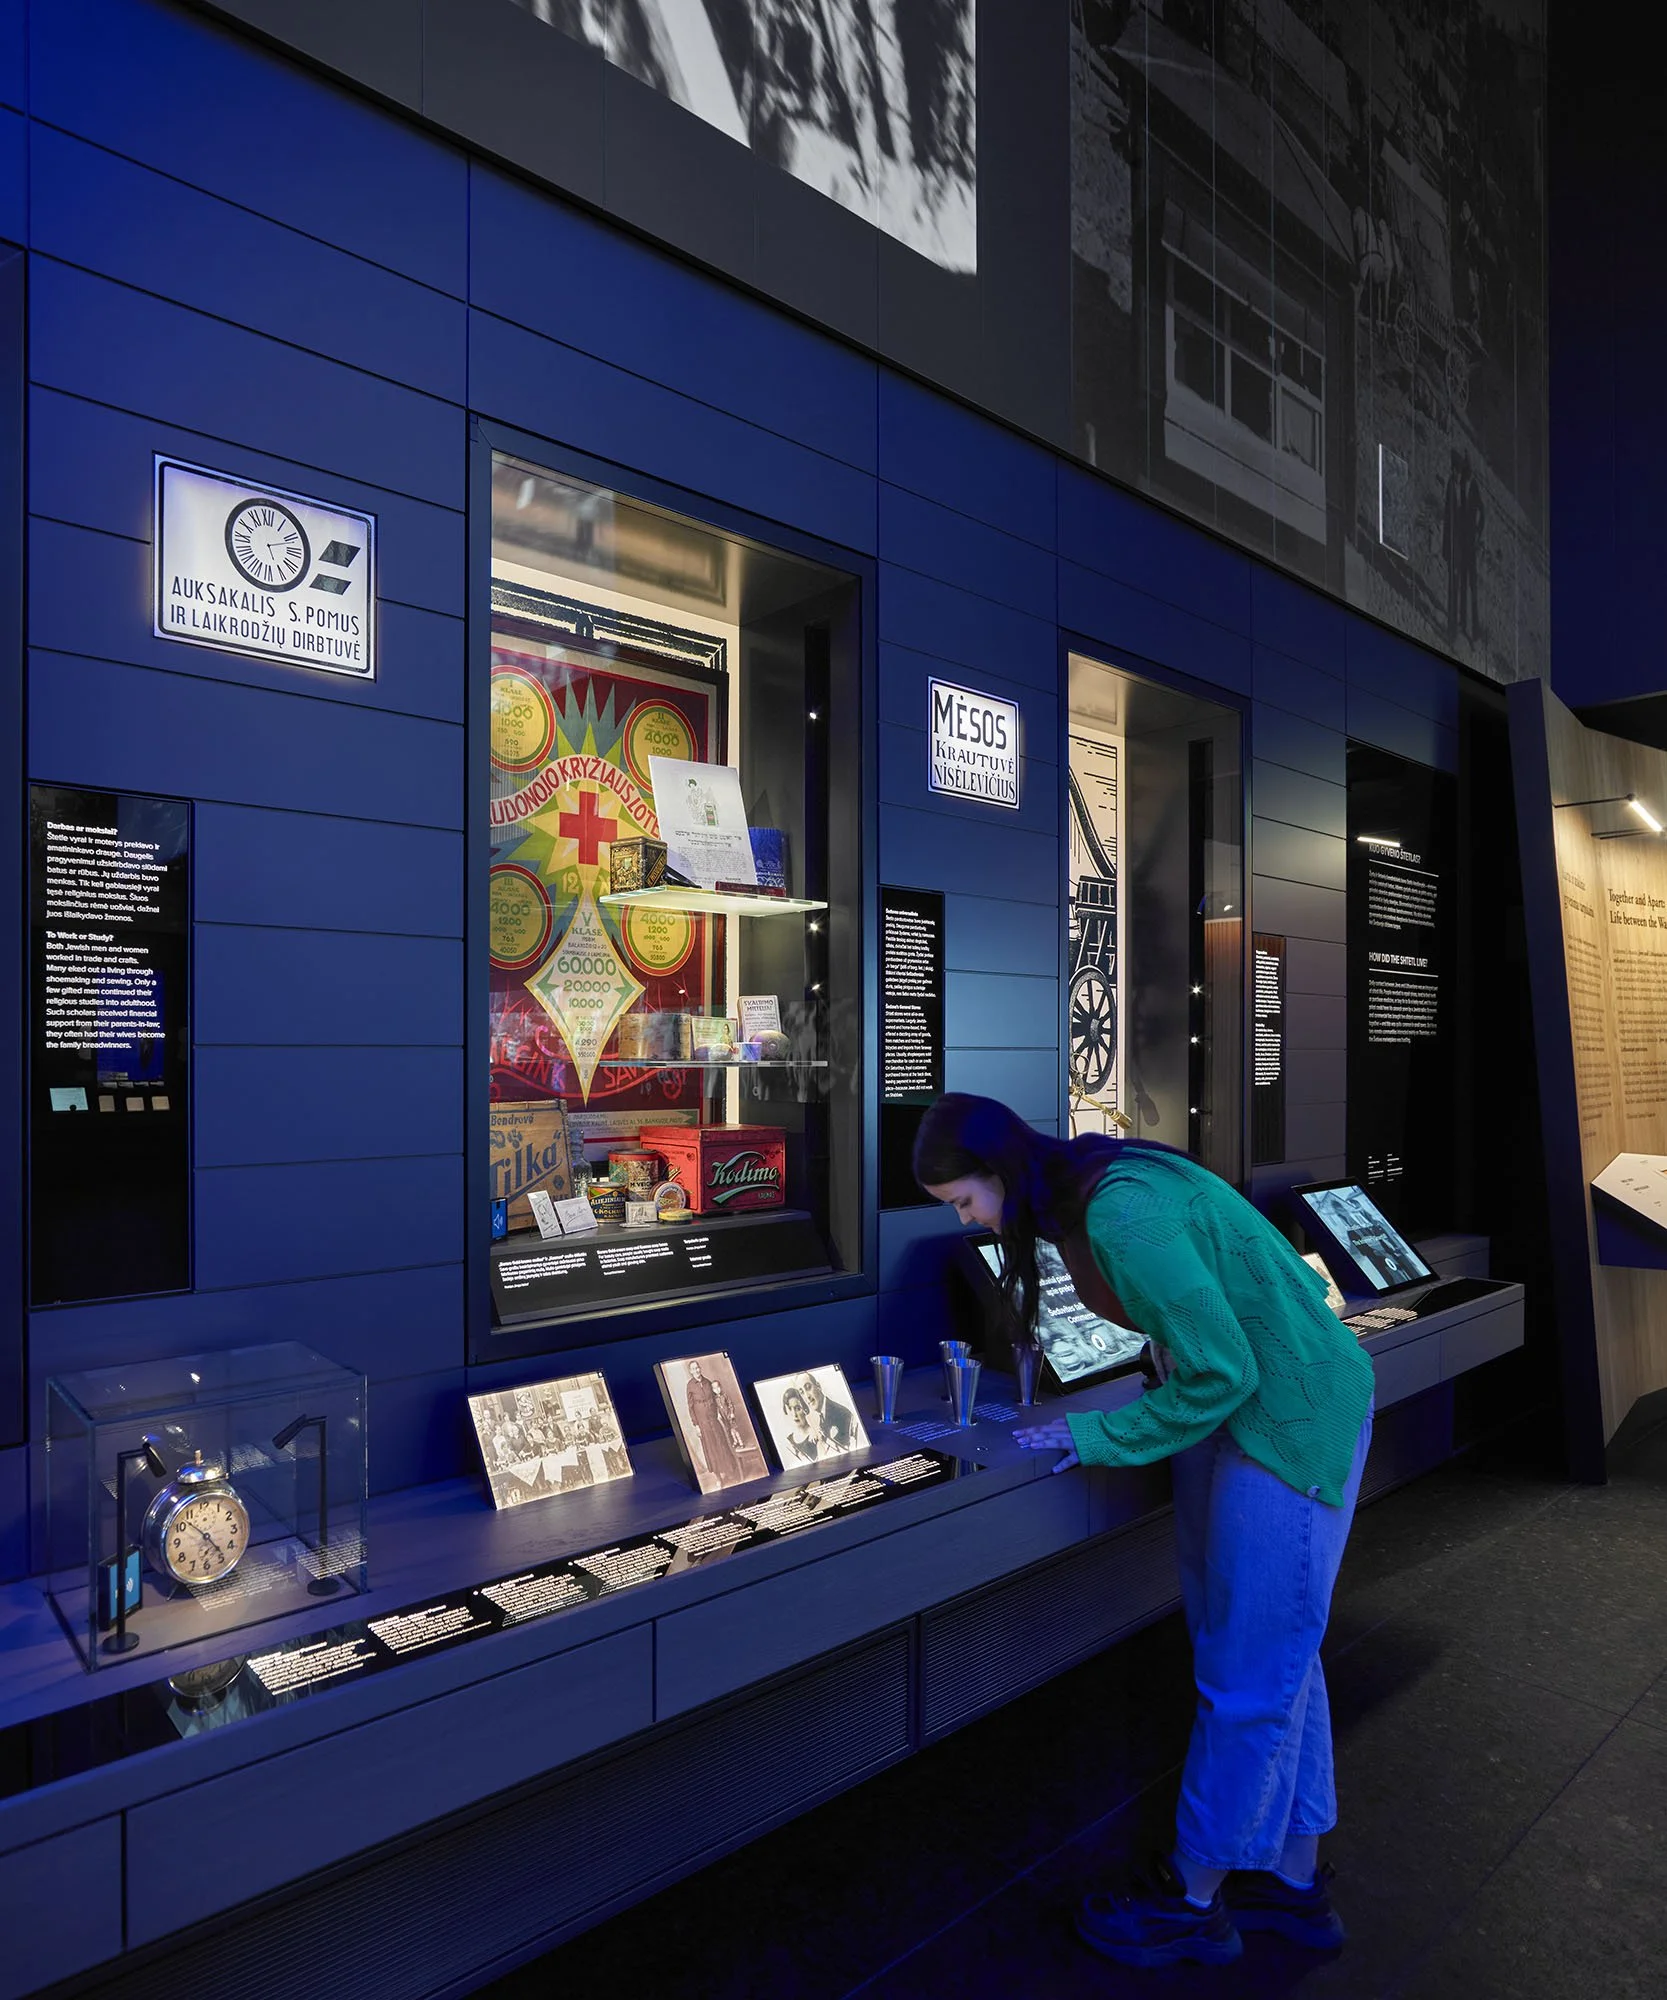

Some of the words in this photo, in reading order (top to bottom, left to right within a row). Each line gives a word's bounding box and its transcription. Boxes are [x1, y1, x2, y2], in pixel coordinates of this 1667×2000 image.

[172, 575, 275, 617] AUKSAKALIS
[171, 604, 185, 625] IR
[192, 608, 286, 649] LAIKRODŽIŲ
[293, 630, 360, 661] DIRBTUVĖ
[934, 690, 1006, 750] MĖSOS
[936, 740, 1014, 774] KRAUTUVĖ
[557, 757, 635, 804] KRYŽIAUS
[1608, 889, 1634, 906] Together
[1635, 893, 1646, 906] and
[1610, 910, 1622, 924] Life
[1623, 912, 1647, 927] between
[1648, 915, 1657, 928] the
[88, 934, 114, 942] Study?
[1382, 954, 1390, 963] DID
[46, 965, 67, 973] Many
[107, 966, 125, 975] living
[46, 976, 90, 984] shoemaking
[134, 978, 150, 986] Only
[61, 987, 82, 995] gifted
